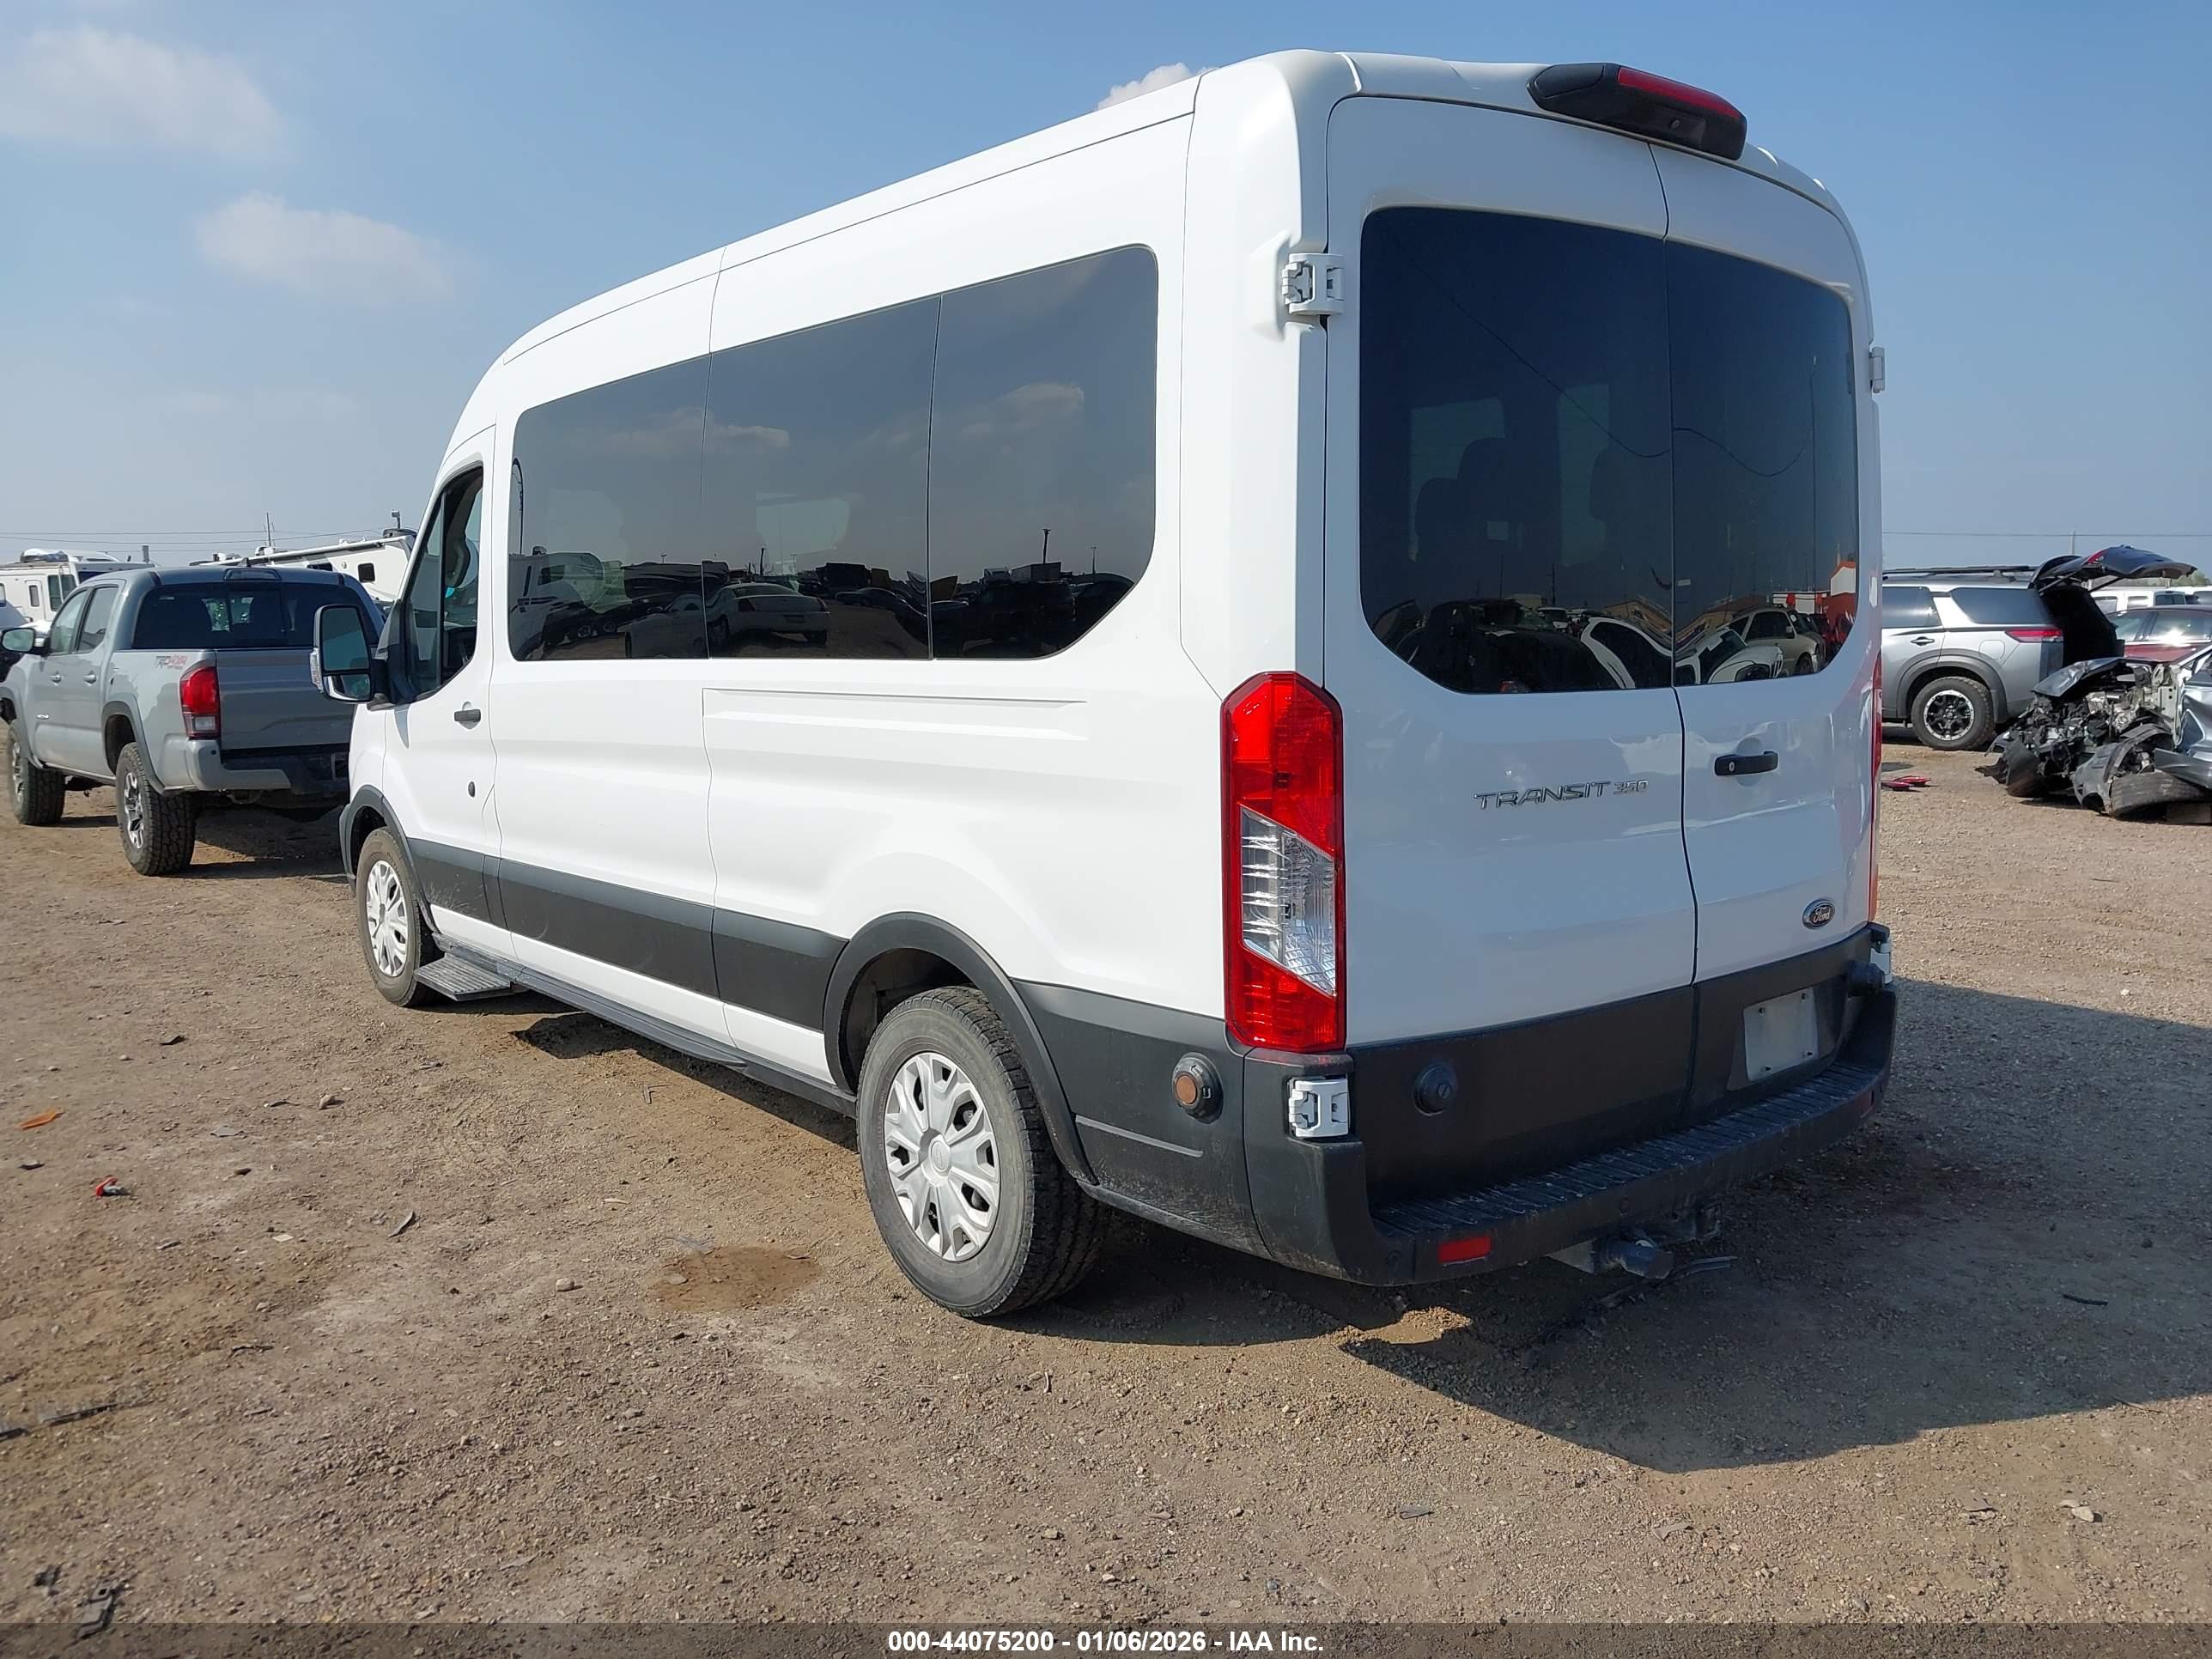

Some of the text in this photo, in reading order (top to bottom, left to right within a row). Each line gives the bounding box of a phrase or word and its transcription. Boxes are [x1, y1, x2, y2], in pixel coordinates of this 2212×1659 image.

[1474, 780, 1649, 810] TRANSIT 350
[1813, 906, 1832, 923] Ford
